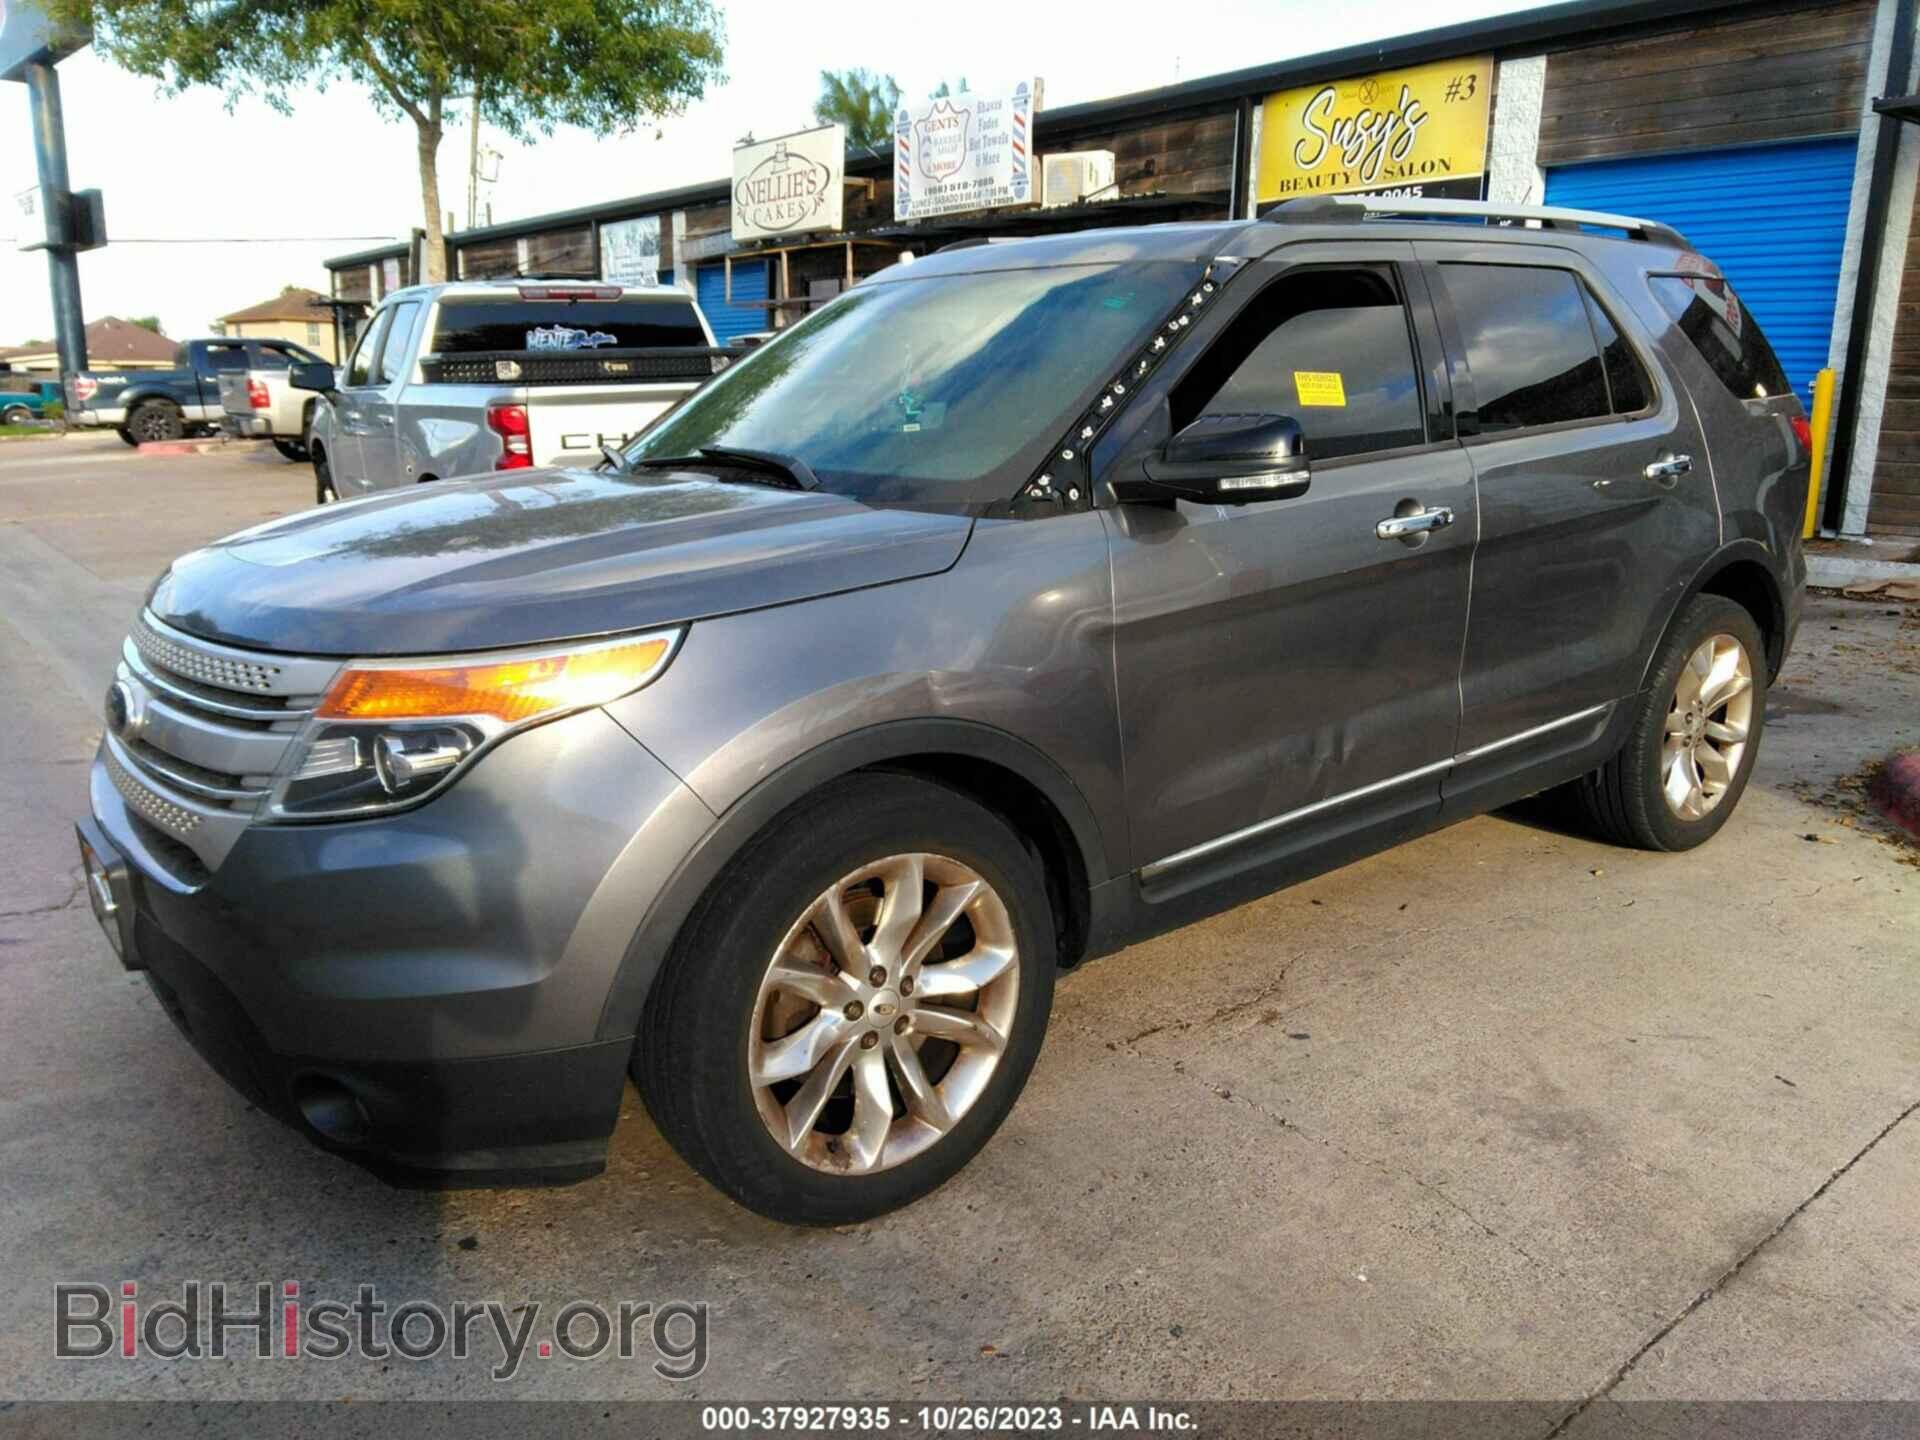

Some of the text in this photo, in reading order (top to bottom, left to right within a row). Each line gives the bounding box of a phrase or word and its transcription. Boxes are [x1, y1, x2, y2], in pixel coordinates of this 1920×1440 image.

[1444, 73, 1478, 103] #3
[924, 117, 960, 133] GENTS
[1295, 84, 1428, 185] Susy's
[745, 168, 817, 206] NELLIE'S
[1279, 157, 1452, 193] BEAUTY SALON
[753, 199, 806, 221] CAKES
